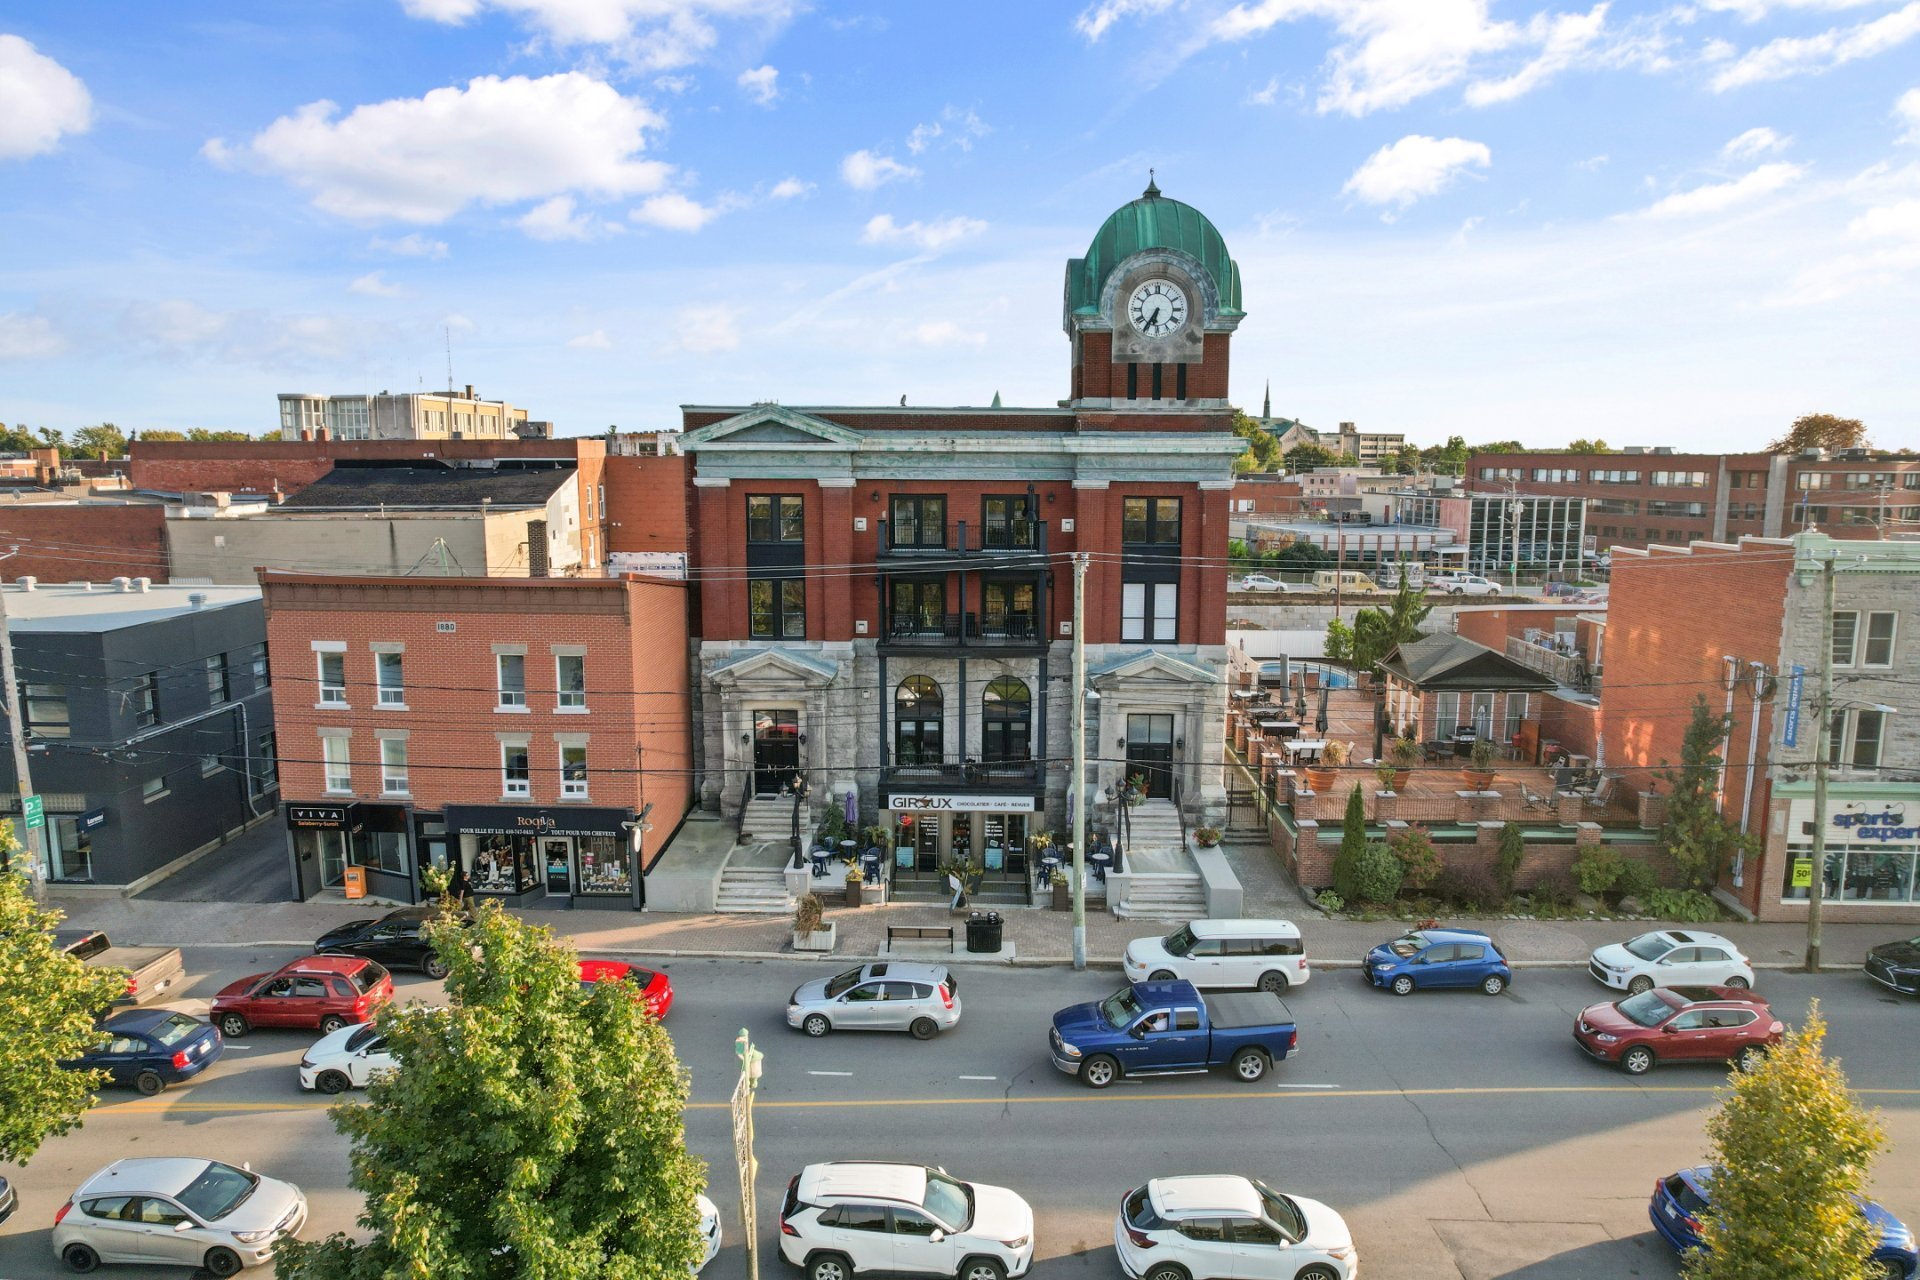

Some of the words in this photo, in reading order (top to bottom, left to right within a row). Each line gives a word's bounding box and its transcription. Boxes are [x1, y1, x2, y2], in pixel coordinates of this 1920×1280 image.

[437, 623, 454, 631] 1880
[297, 810, 339, 819] VIVA
[1833, 811, 1904, 829] sports
